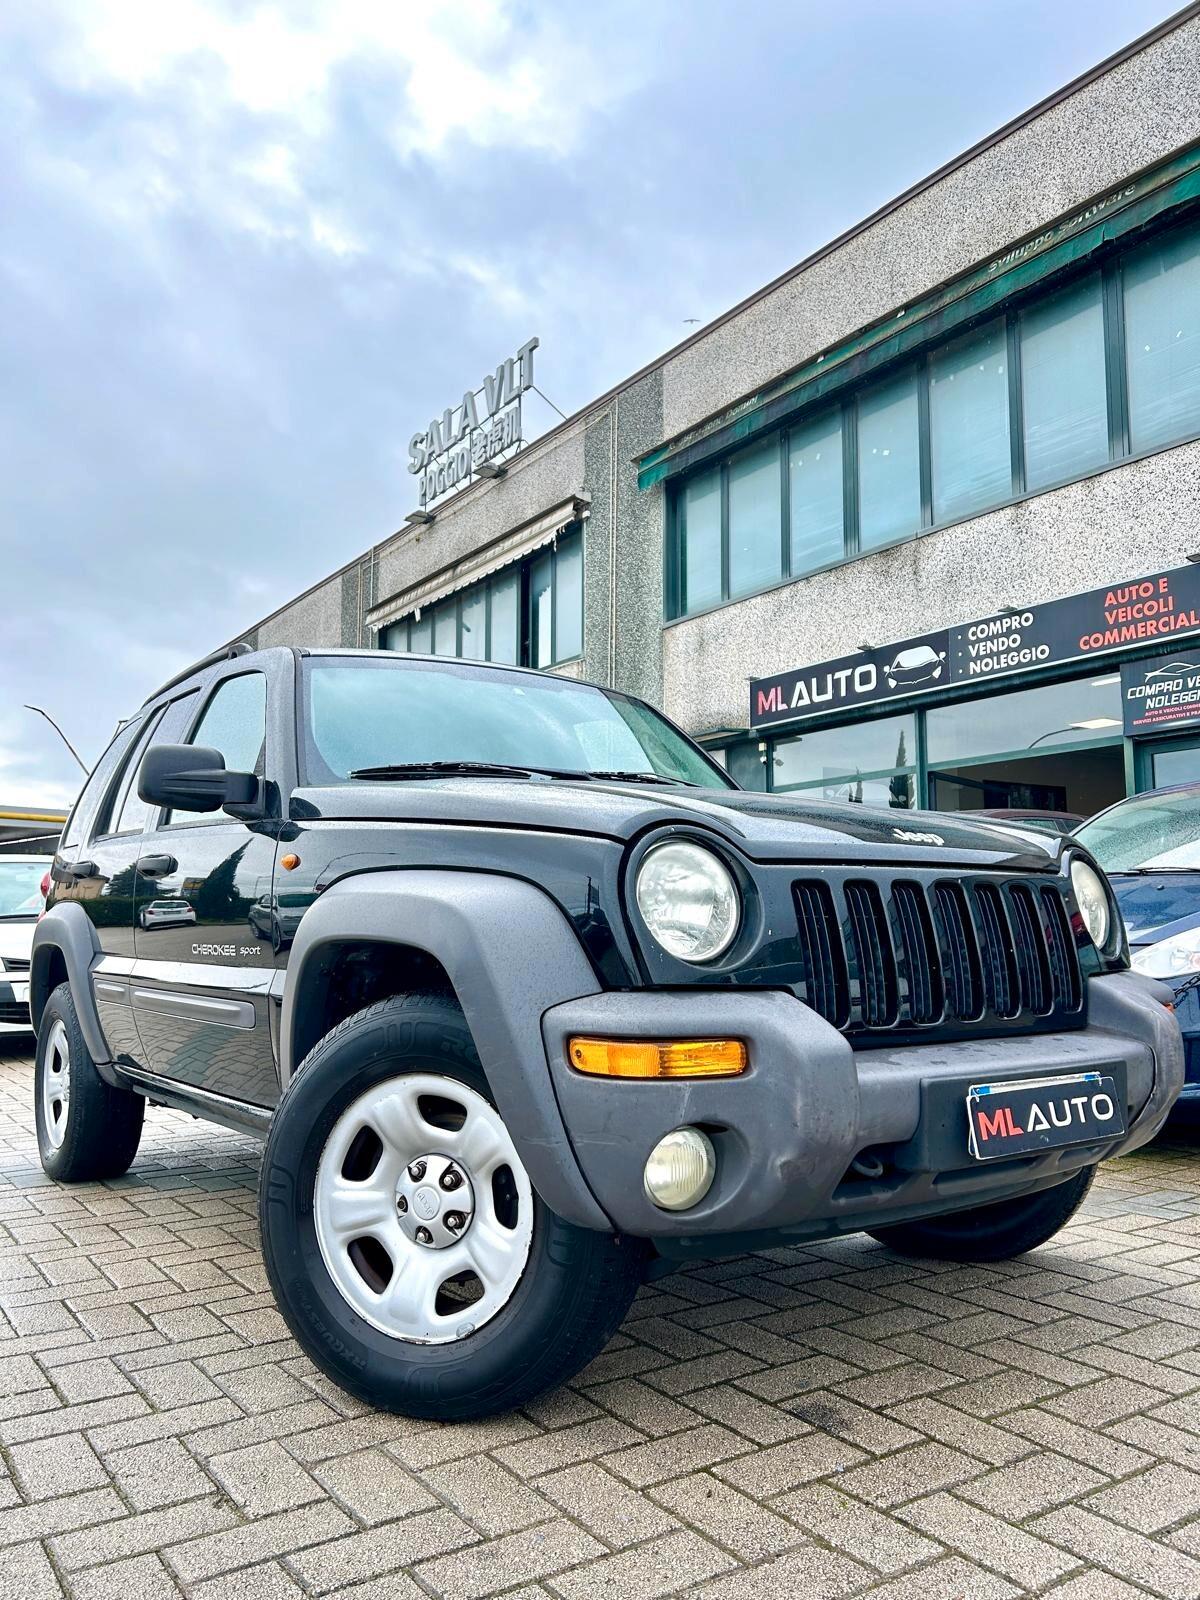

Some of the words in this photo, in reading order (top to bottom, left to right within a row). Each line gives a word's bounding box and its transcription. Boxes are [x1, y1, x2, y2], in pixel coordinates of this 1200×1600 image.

[408, 391, 479, 474] SALA
[483, 337, 540, 417] VLT
[419, 446, 471, 506] POGGIO
[1104, 582, 1154, 608] AUTO
[1159, 577, 1169, 594] E
[1104, 596, 1174, 625] VEICOLI
[968, 612, 1034, 641] COMPRO
[968, 633, 1021, 658] VENDO
[969, 644, 1050, 675] NOLEGGIO
[1127, 679, 1183, 699] COMPRO
[893, 828, 945, 846] Jeep
[191, 943, 236, 956] CHEROKEE
[240, 946, 261, 957] sport
